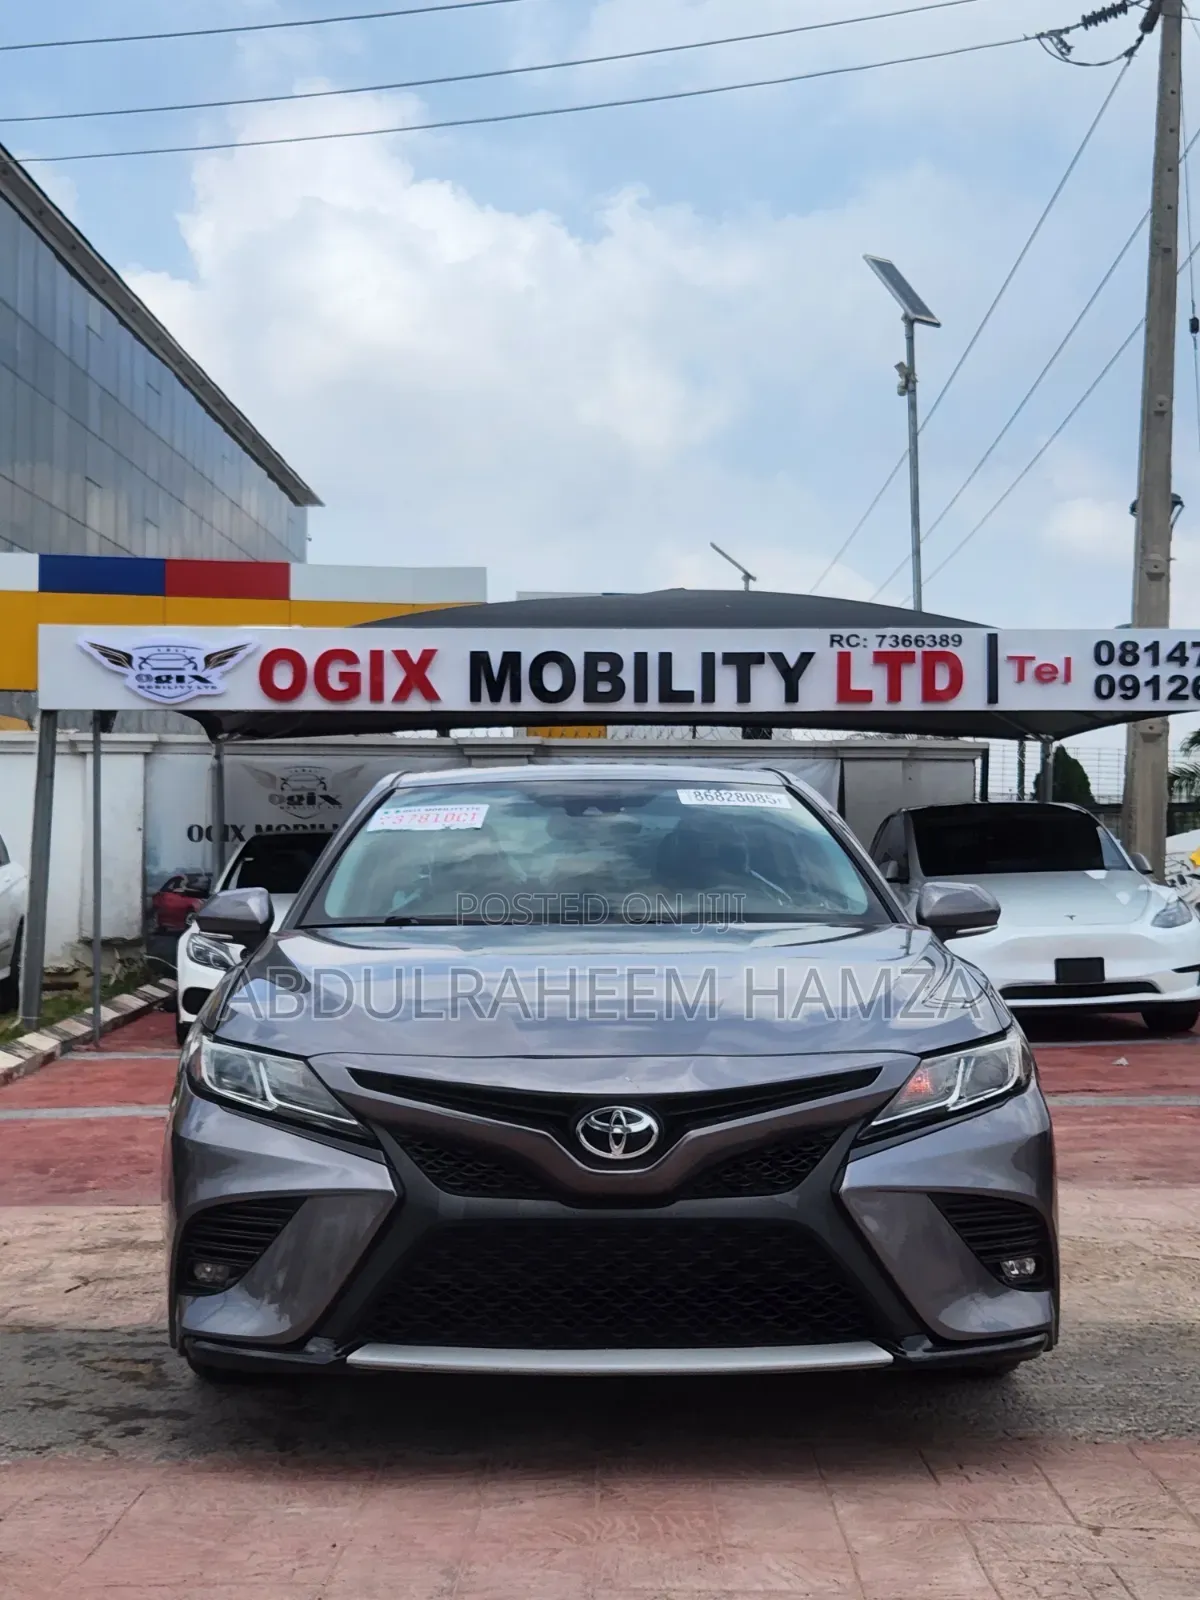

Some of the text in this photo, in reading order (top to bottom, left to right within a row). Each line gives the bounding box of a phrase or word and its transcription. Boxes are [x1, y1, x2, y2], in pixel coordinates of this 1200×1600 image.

[829, 633, 964, 648] RC: 7366389
[257, 648, 965, 704] OGIX MOBILITY LTD
[1006, 655, 1073, 685] Tel
